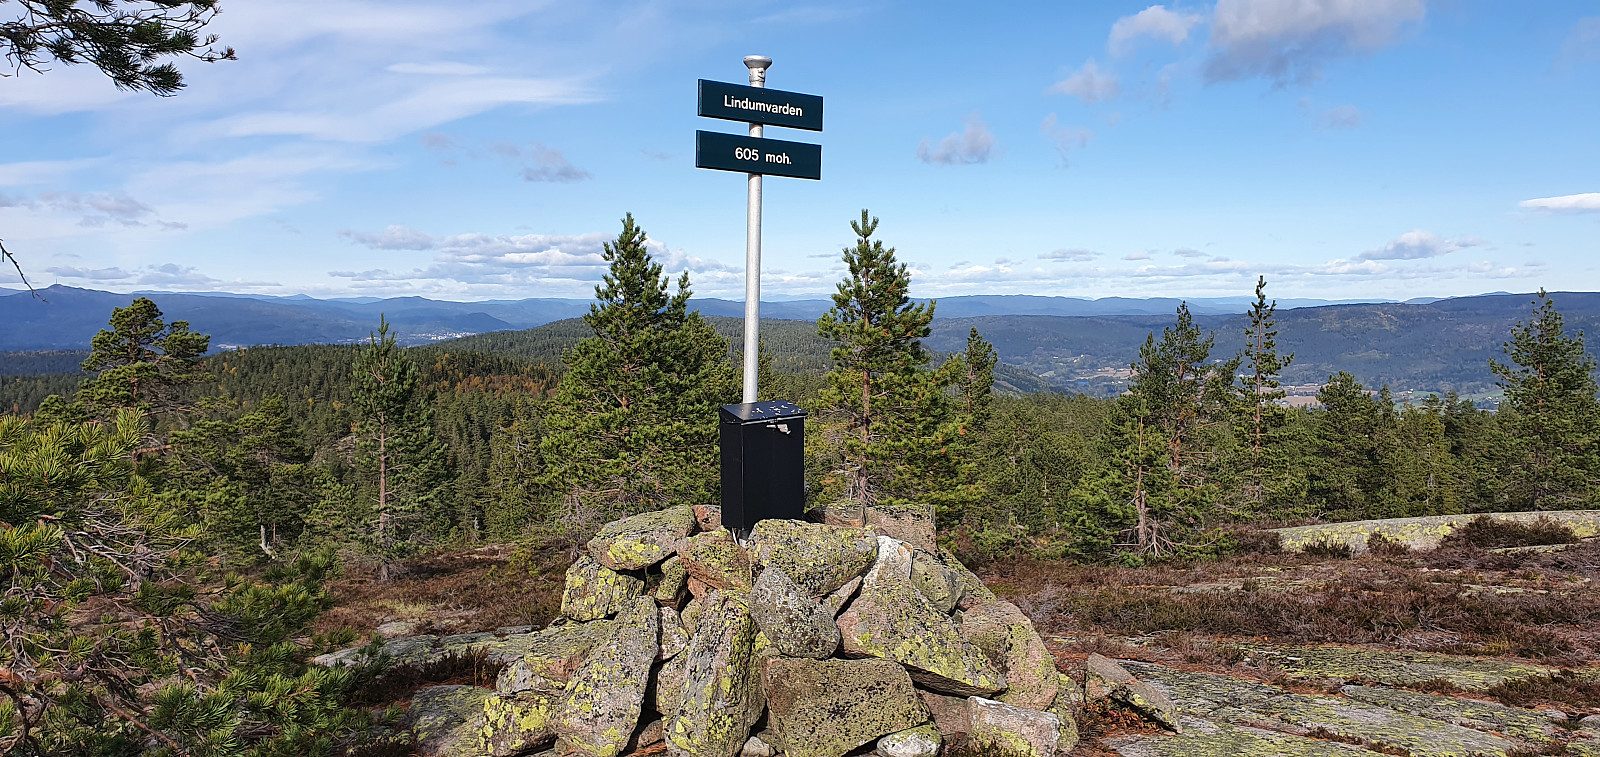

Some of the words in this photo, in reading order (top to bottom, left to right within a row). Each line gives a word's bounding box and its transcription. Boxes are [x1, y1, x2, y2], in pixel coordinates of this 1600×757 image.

[724, 95, 803, 116] Lindumvarden
[735, 147, 760, 161] 605
[765, 153, 792, 165] moh.
